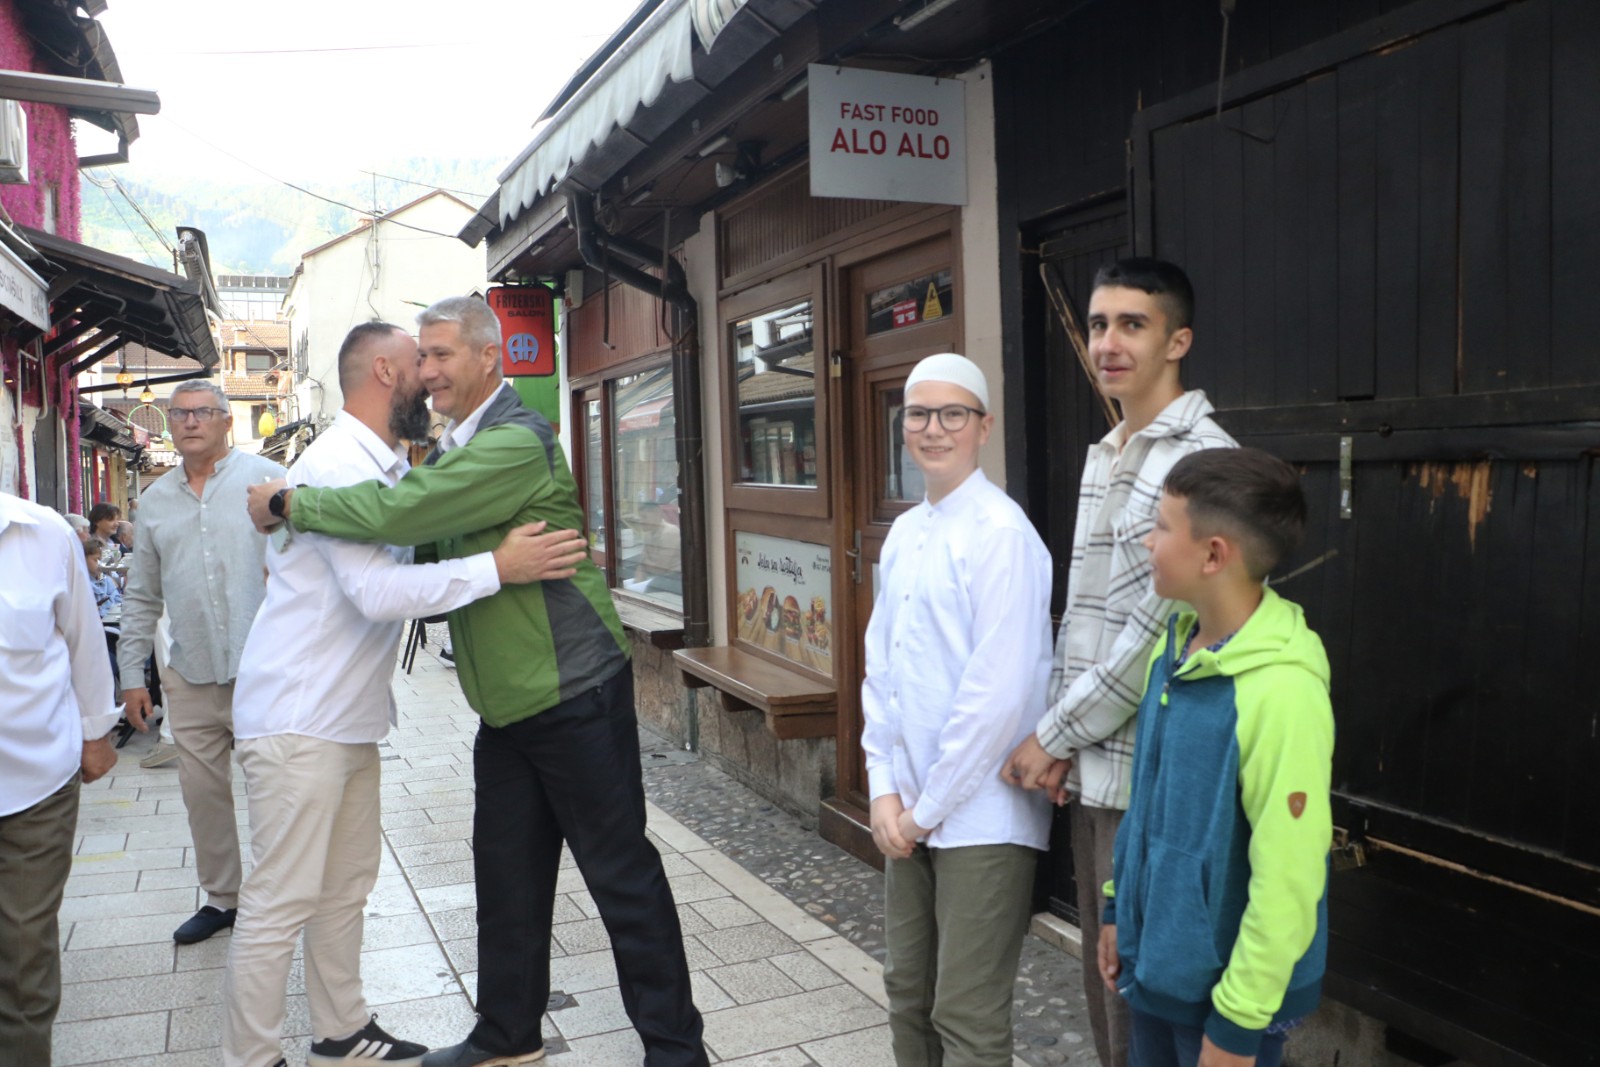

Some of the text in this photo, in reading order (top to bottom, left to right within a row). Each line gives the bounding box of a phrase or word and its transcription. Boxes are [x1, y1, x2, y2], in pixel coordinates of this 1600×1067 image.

[840, 102, 939, 127] FAST FOOD
[830, 127, 950, 160] ALO ALO
[496, 294, 545, 309] FRIZERSKI
[508, 310, 546, 318] SALON
